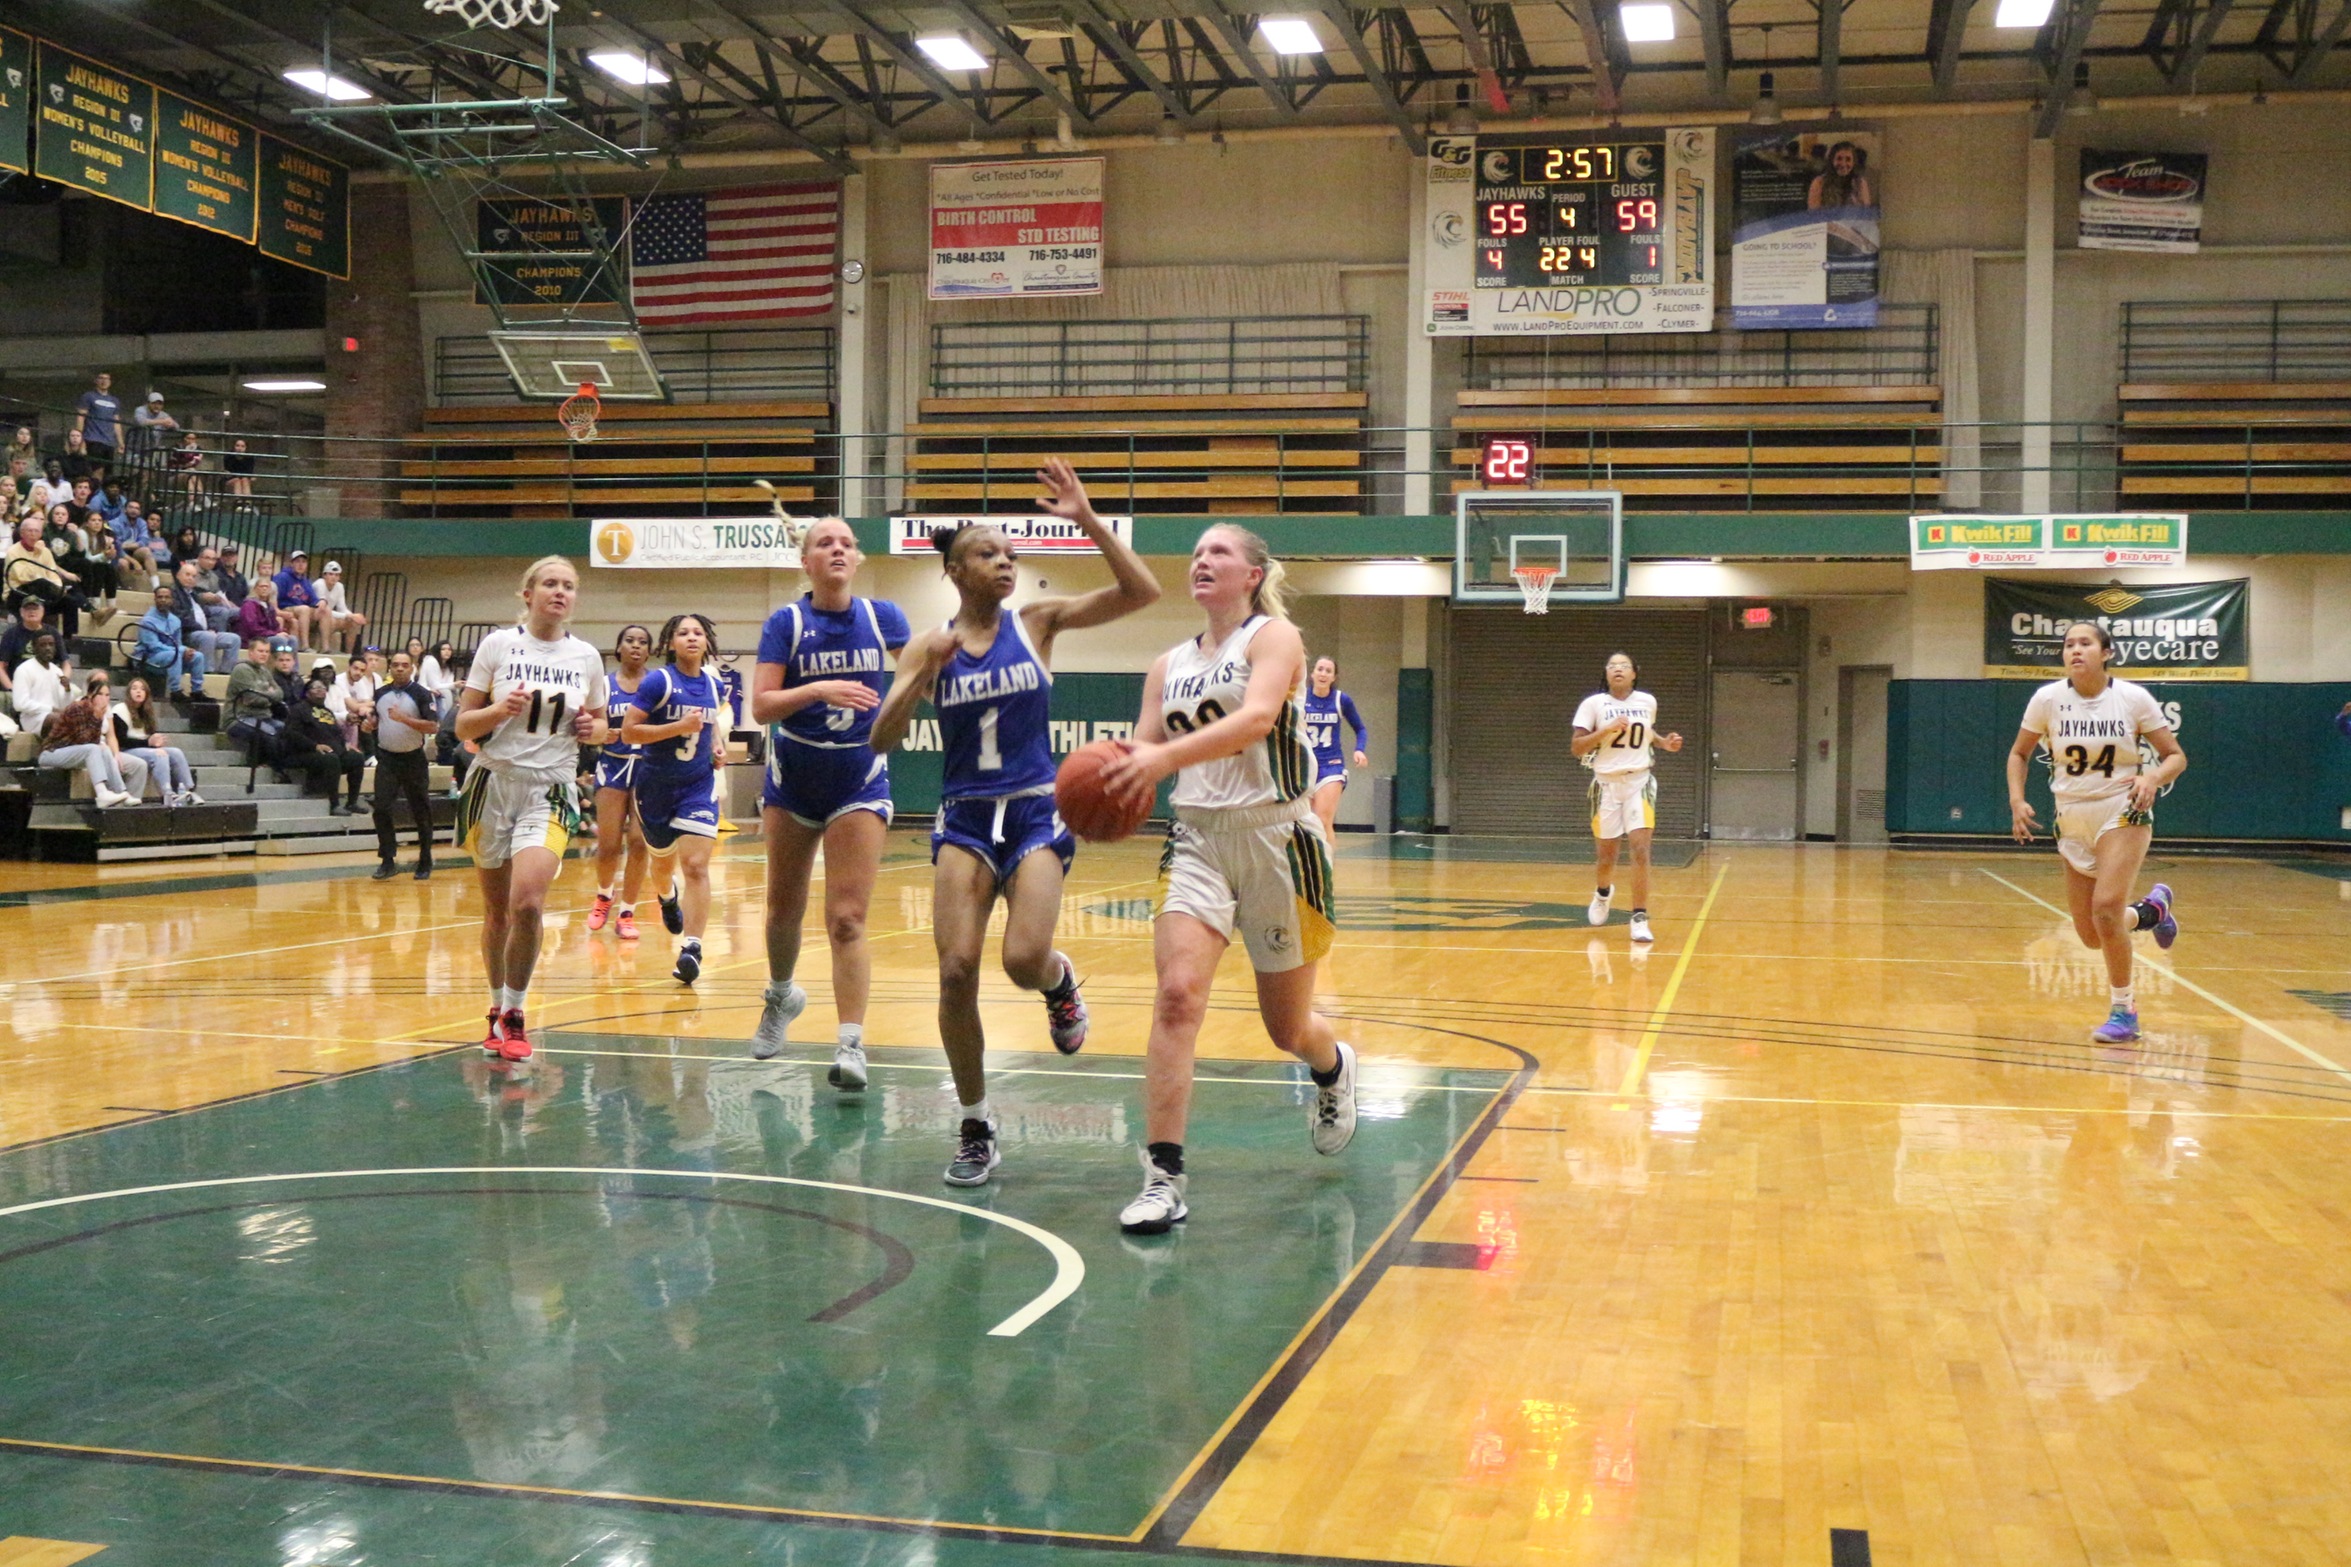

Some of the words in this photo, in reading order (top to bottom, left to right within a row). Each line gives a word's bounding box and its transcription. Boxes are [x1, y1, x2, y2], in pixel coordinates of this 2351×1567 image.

[65, 64, 130, 104] JAYHAWKS
[72, 94, 107, 118] REGION
[110, 108, 121, 123] III
[43, 106, 85, 132] WOMEN'S
[88, 121, 146, 154] VOLLEYBALL
[180, 109, 240, 148] JAYHAWKS
[70, 140, 123, 168] CHAMPIONS
[1545, 148, 1612, 179] 2:57
[162, 149, 199, 173] WOMEN'S
[201, 164, 250, 192] VOLLEYBALL
[279, 153, 332, 187] JAYHAWKS
[972, 171, 991, 183] Get
[993, 170, 1027, 182] Tested
[1030, 169, 1063, 181] Today!
[2118, 158, 2164, 178] Team
[186, 179, 232, 204] CHAMPIONS
[1477, 186, 1545, 201] JAYHAWKS
[1552, 193, 1586, 203] PERIOD
[1611, 183, 1656, 197] GUEST
[508, 206, 595, 225] JAYHAWS
[937, 211, 976, 227] BIRTH
[978, 208, 1037, 225] CONTROL
[1489, 204, 1527, 234] 55
[1561, 207, 1575, 228] 4
[1619, 201, 1657, 231] 59
[520, 230, 562, 242] REGION
[1018, 228, 1043, 244] STD
[1046, 226, 1099, 242] TESTING
[1478, 238, 1507, 248] FOULS
[1539, 236, 1574, 246] PLAYER
[1577, 235, 1600, 245] FOUL
[1630, 234, 1661, 244] FOULS
[1029, 248, 1097, 261] 716-753-4491
[1650, 246, 1656, 267] 1
[1743, 243, 1768, 251] GOING
[1770, 242, 1779, 250] TO
[936, 251, 1005, 264] 716-484-4334
[1488, 250, 1502, 270] 4
[1540, 247, 1571, 271] 22
[1580, 248, 1595, 268] 4
[516, 266, 583, 279] CHAMPIONS
[1477, 277, 1507, 287] SCORE
[1551, 275, 1584, 285] MATCH
[1630, 274, 1660, 283] SCORE
[1432, 291, 1470, 301] STIHL
[1498, 288, 1641, 316] LANDPRO
[1489, 445, 1528, 477] 22
[640, 525, 680, 550] JOHN
[691, 524, 707, 550] S.
[713, 524, 806, 549] TRUSSA
[1983, 553, 2004, 562] RED
[2006, 553, 2036, 562] APPLE
[2120, 552, 2140, 562] RED
[2141, 552, 2172, 562] APPLE
[2011, 613, 2218, 642] Chatauqua
[2035, 645, 2061, 655] Your
[799, 649, 879, 677] LAKELAND
[506, 663, 581, 690] JAYHAWKS
[941, 661, 1039, 708] LAKELAND
[527, 689, 566, 735] 11
[1604, 708, 1648, 720] JAYHAWKS
[978, 706, 1003, 770] 1
[1306, 725, 1332, 748] 34
[1611, 722, 1644, 749] 20
[2058, 720, 2125, 737] JAYHAWKS
[2065, 744, 2116, 778] 34
